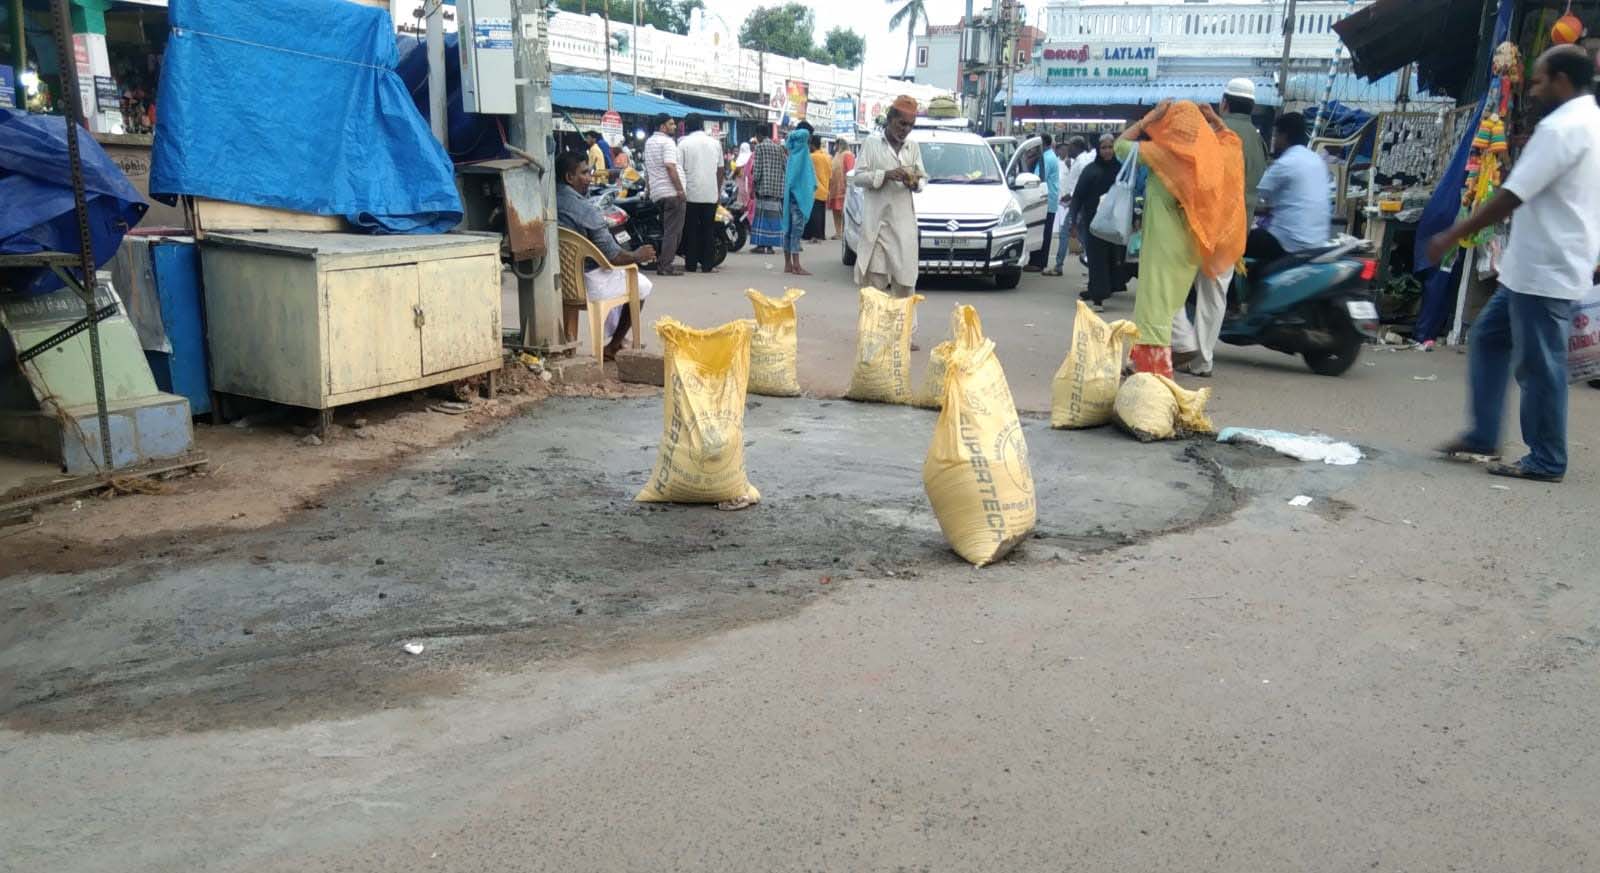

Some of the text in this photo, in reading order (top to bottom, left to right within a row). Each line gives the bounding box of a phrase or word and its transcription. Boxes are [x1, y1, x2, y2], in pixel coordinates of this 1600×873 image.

[1104, 47, 1155, 60] LAYLATI
[1047, 67, 1149, 77] SWEETS & SNACKS
[1069, 331, 1088, 422] SUPERTECH
